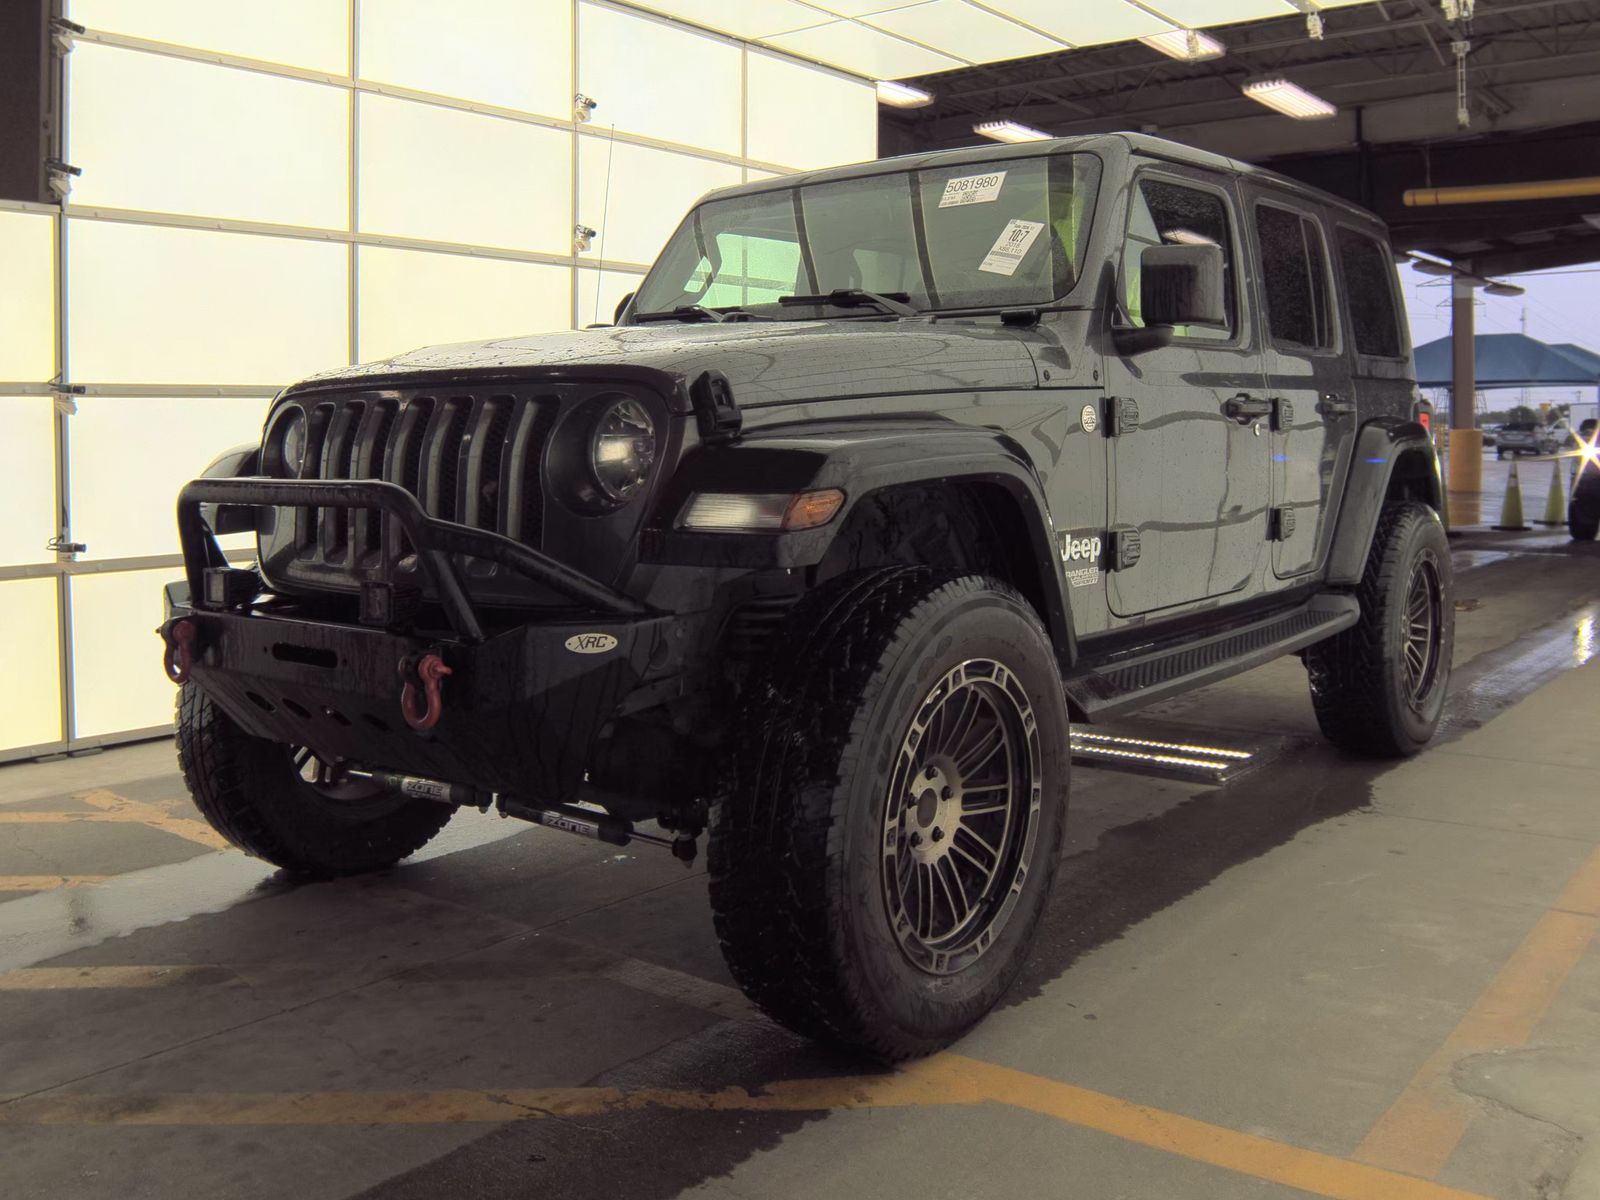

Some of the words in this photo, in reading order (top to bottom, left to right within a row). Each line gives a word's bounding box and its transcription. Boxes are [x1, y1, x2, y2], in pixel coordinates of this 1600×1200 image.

[946, 176, 999, 193] 5081980
[1008, 229, 1031, 242] 10:7
[1061, 534, 1101, 562] Jeep
[1064, 567, 1099, 578] RANGLER
[575, 635, 608, 650] XRC
